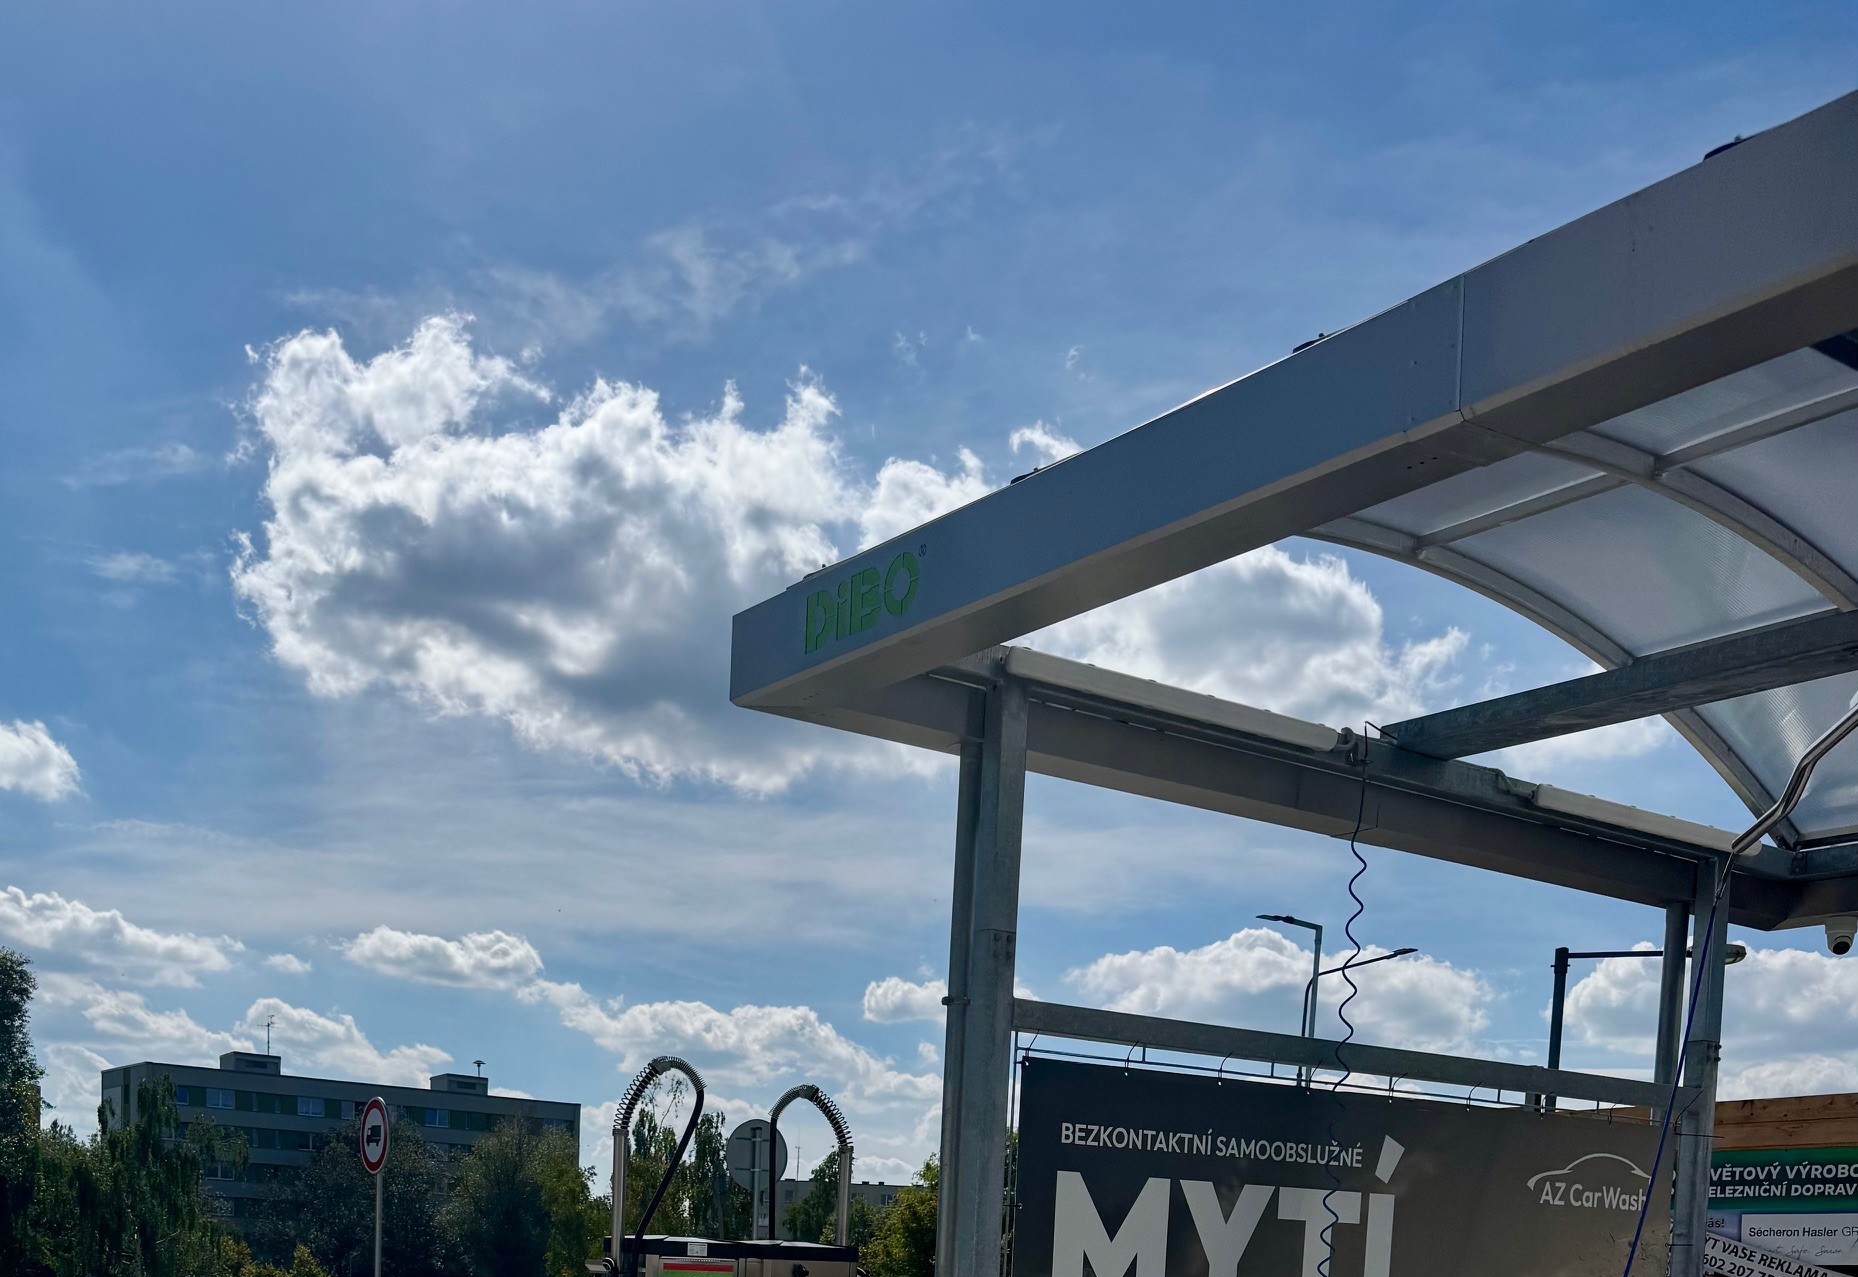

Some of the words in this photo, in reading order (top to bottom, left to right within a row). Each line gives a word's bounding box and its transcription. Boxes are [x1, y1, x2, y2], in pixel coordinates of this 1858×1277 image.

[1061, 1122, 1213, 1156] BEZKONTAKTNÍ
[1216, 1135, 1363, 1168] SAMOOBSLUŽNÉ
[1710, 1162, 1781, 1181] VĚTOVÝ
[1540, 1181, 1567, 1206] AZ
[1569, 1183, 1647, 1212] CarWash
[1708, 1181, 1788, 1198] ELEZNIČNÍ
[1707, 1218, 1725, 1228] ás!
[1802, 1227, 1838, 1237] Hasler
